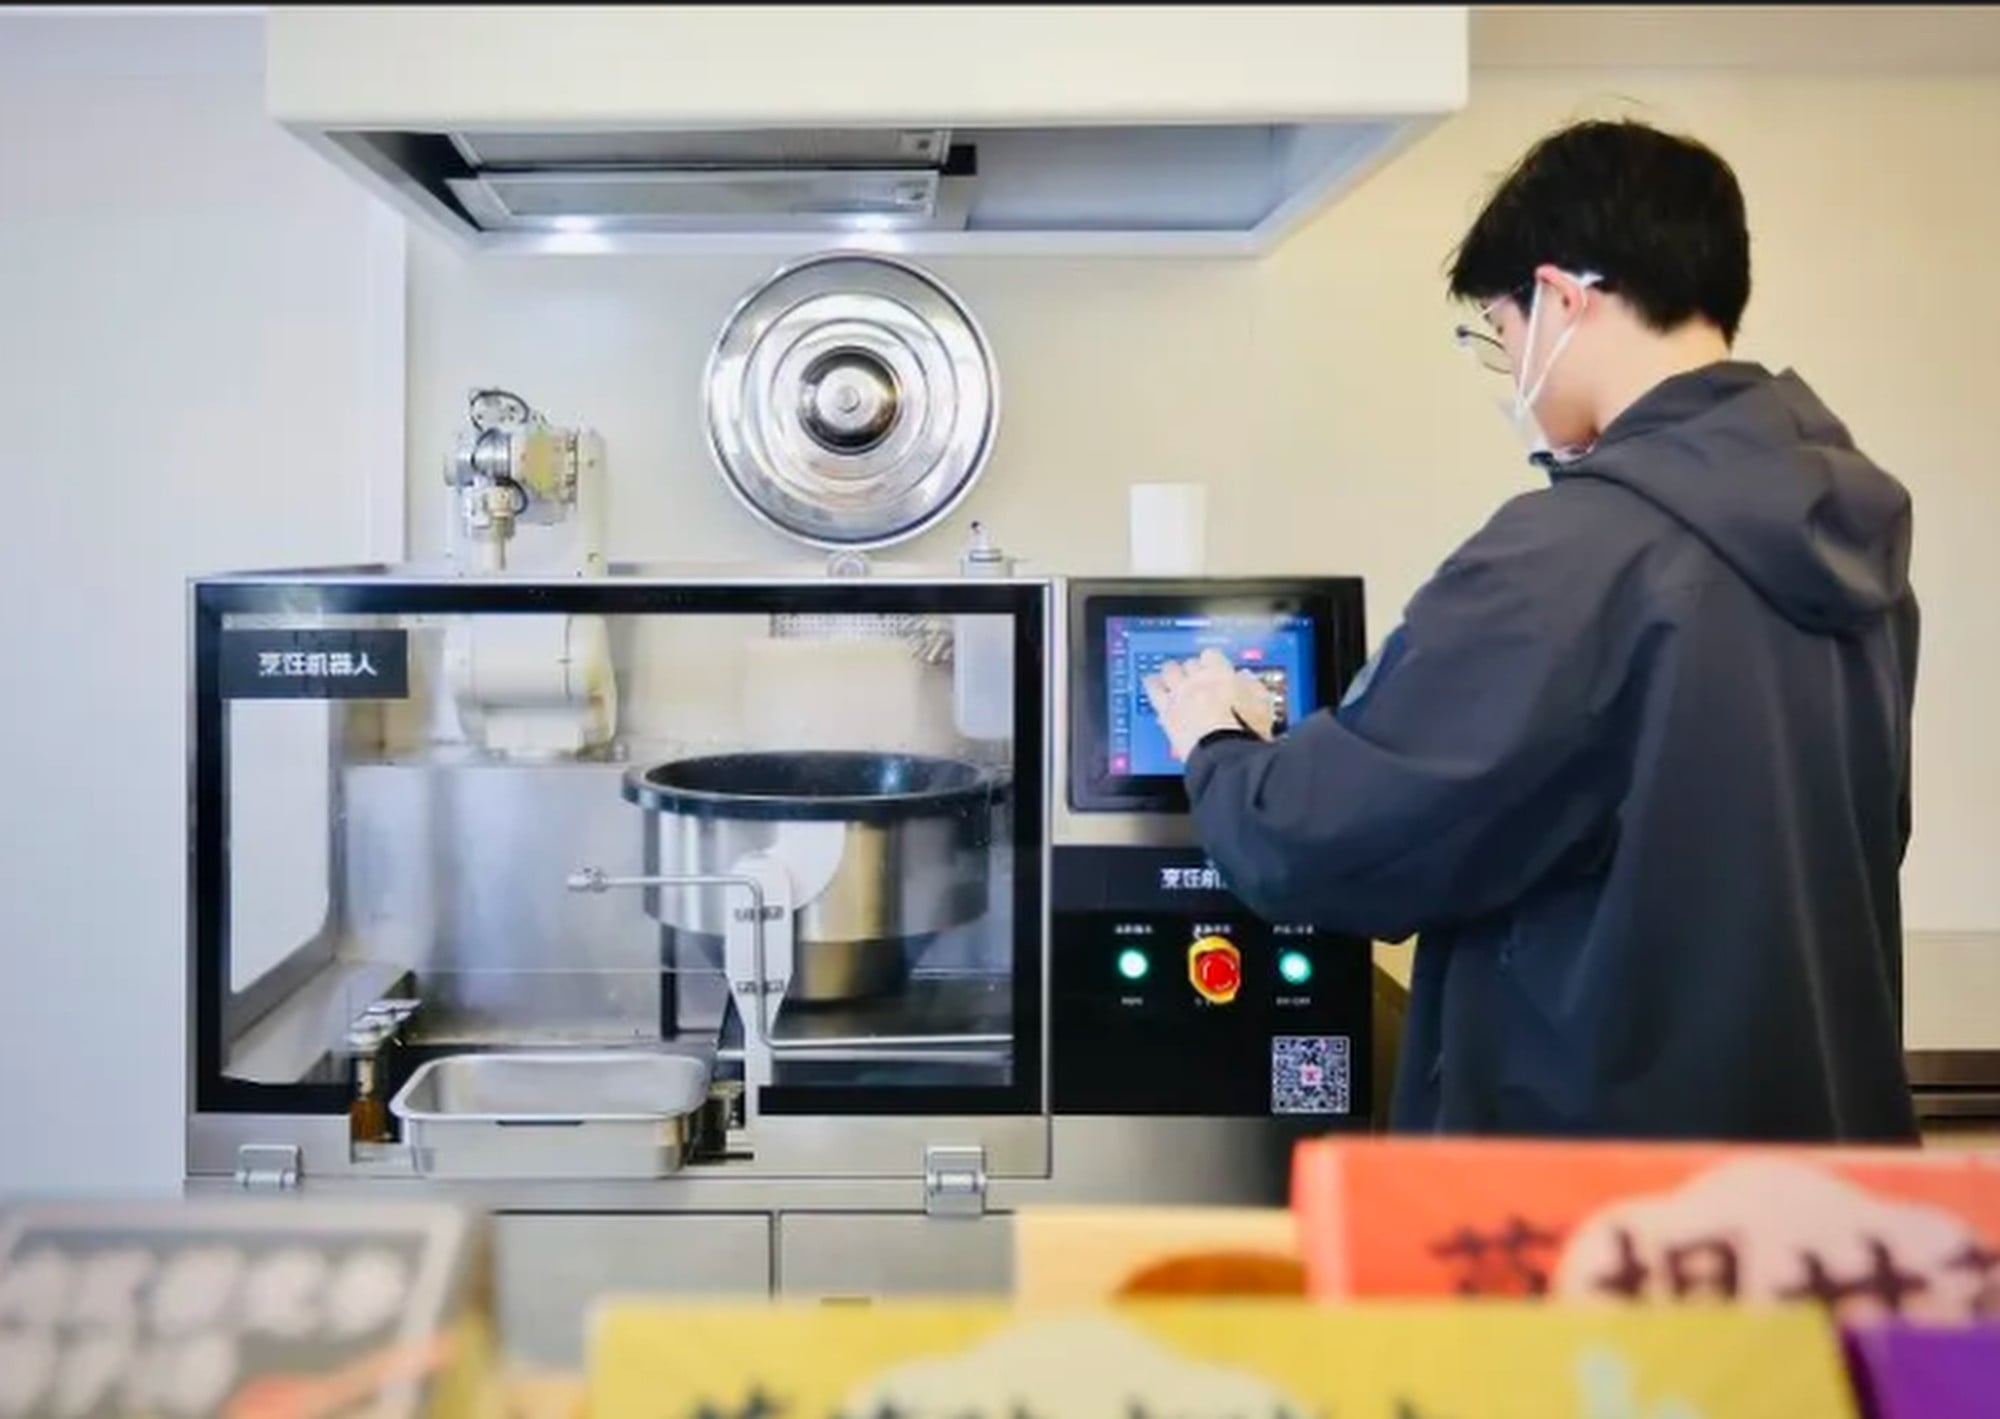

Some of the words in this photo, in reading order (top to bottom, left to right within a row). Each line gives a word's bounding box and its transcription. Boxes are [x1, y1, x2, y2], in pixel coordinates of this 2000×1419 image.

[258, 651, 378, 677] 烹饪机器人
[1160, 867, 1227, 889] 烹饪机
